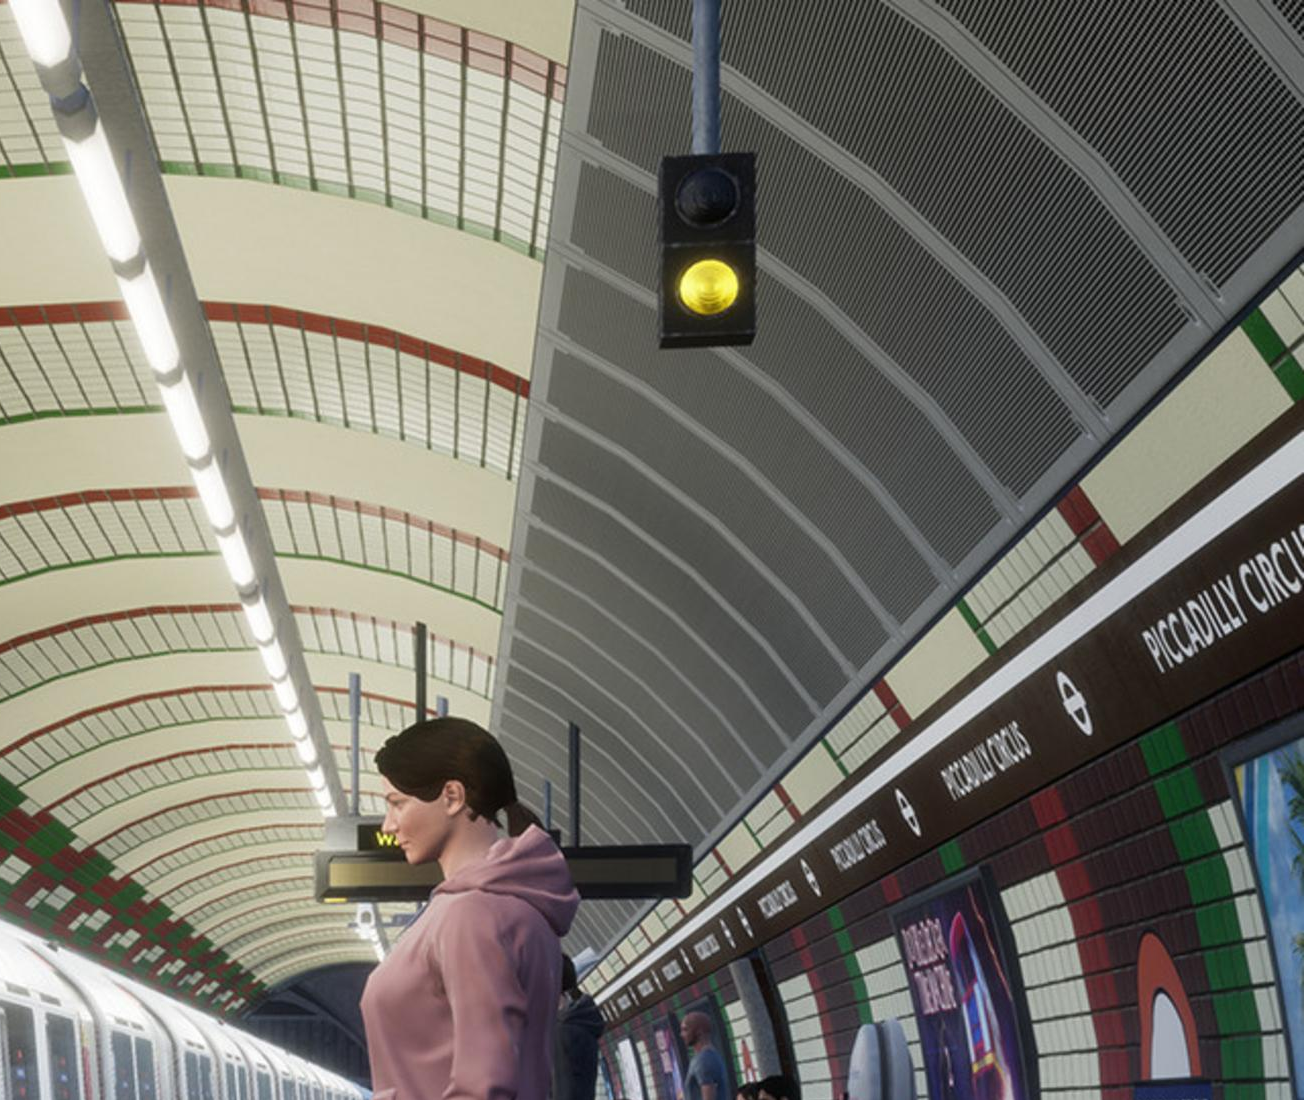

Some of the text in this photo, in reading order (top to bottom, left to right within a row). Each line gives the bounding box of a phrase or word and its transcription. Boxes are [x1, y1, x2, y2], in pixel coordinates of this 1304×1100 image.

[1141, 574, 1248, 674] PICCADILLY
[940, 720, 1032, 801] PICCADILLY CIRCUS
